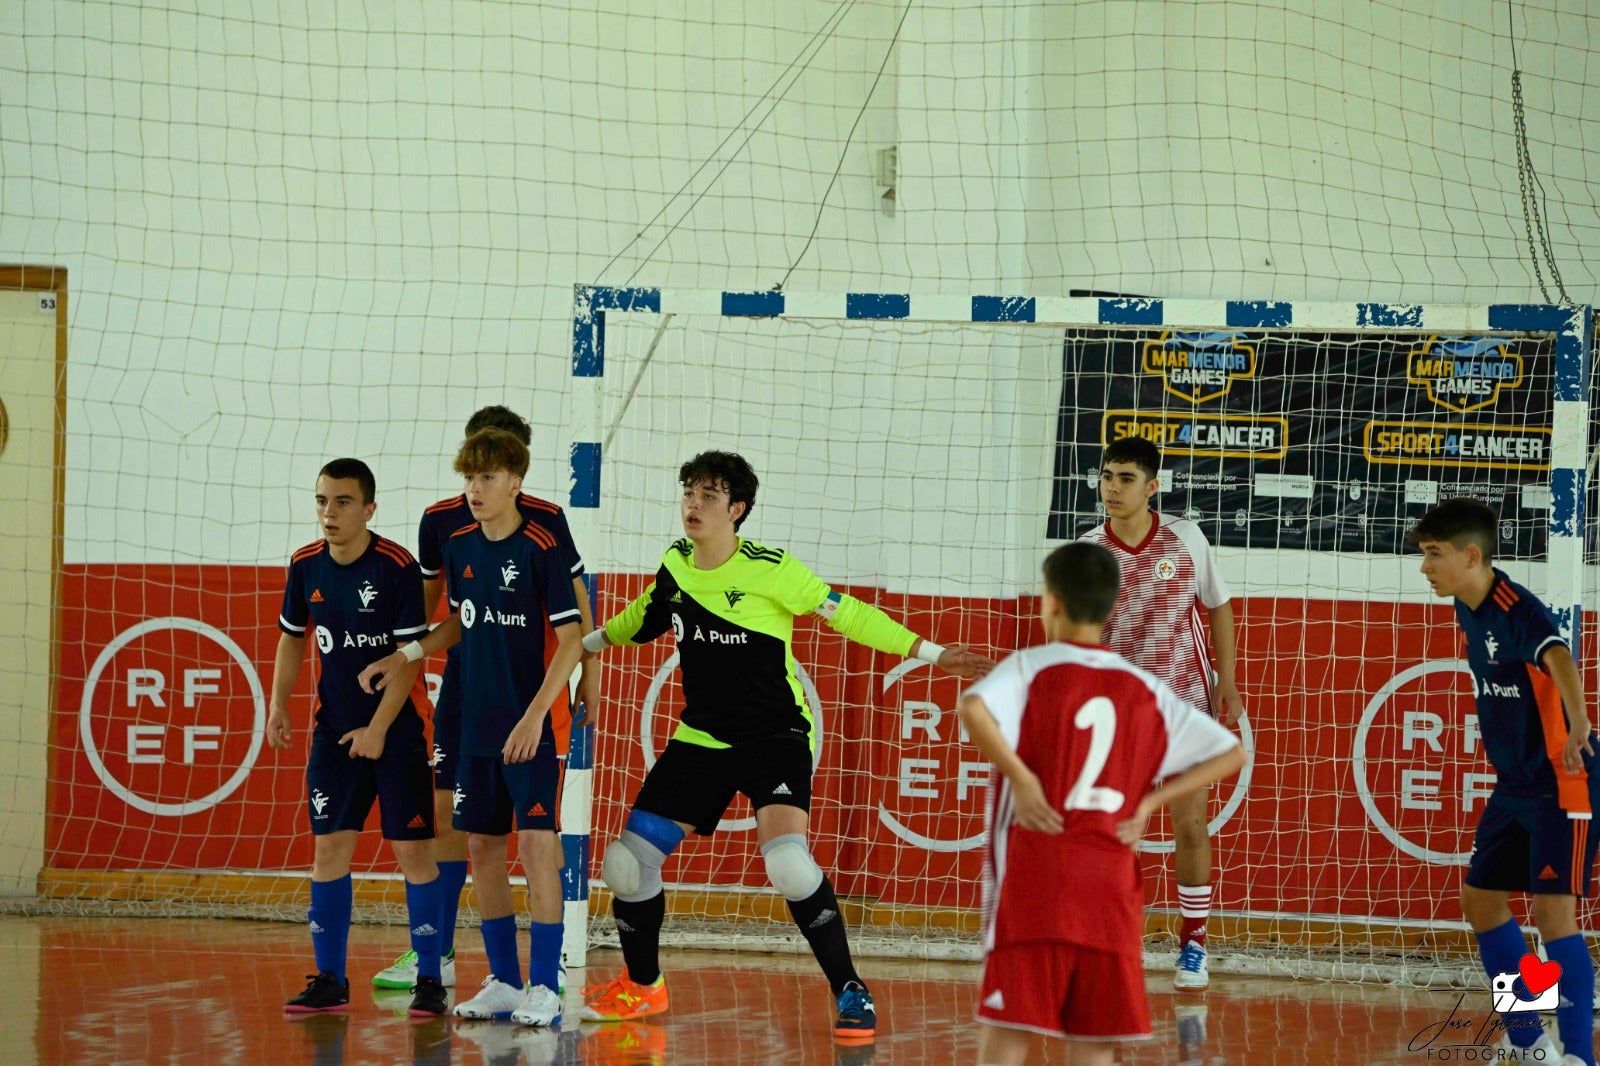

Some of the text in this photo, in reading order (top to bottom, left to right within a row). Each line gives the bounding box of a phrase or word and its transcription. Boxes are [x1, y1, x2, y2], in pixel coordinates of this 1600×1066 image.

[41, 298, 56, 310] 53
[1171, 368, 1226, 385] GAMES
[1436, 378, 1492, 394] GAMES
[1176, 472, 1222, 481] Cofnanciad
[343, 631, 356, 648] À
[356, 632, 388, 648] Punt
[693, 624, 706, 642] À
[709, 630, 748, 644] Punt
[127, 668, 222, 708] RF
[1491, 682, 1521, 698] Punt
[127, 725, 221, 764] EF
[1064, 696, 1125, 813] 2
